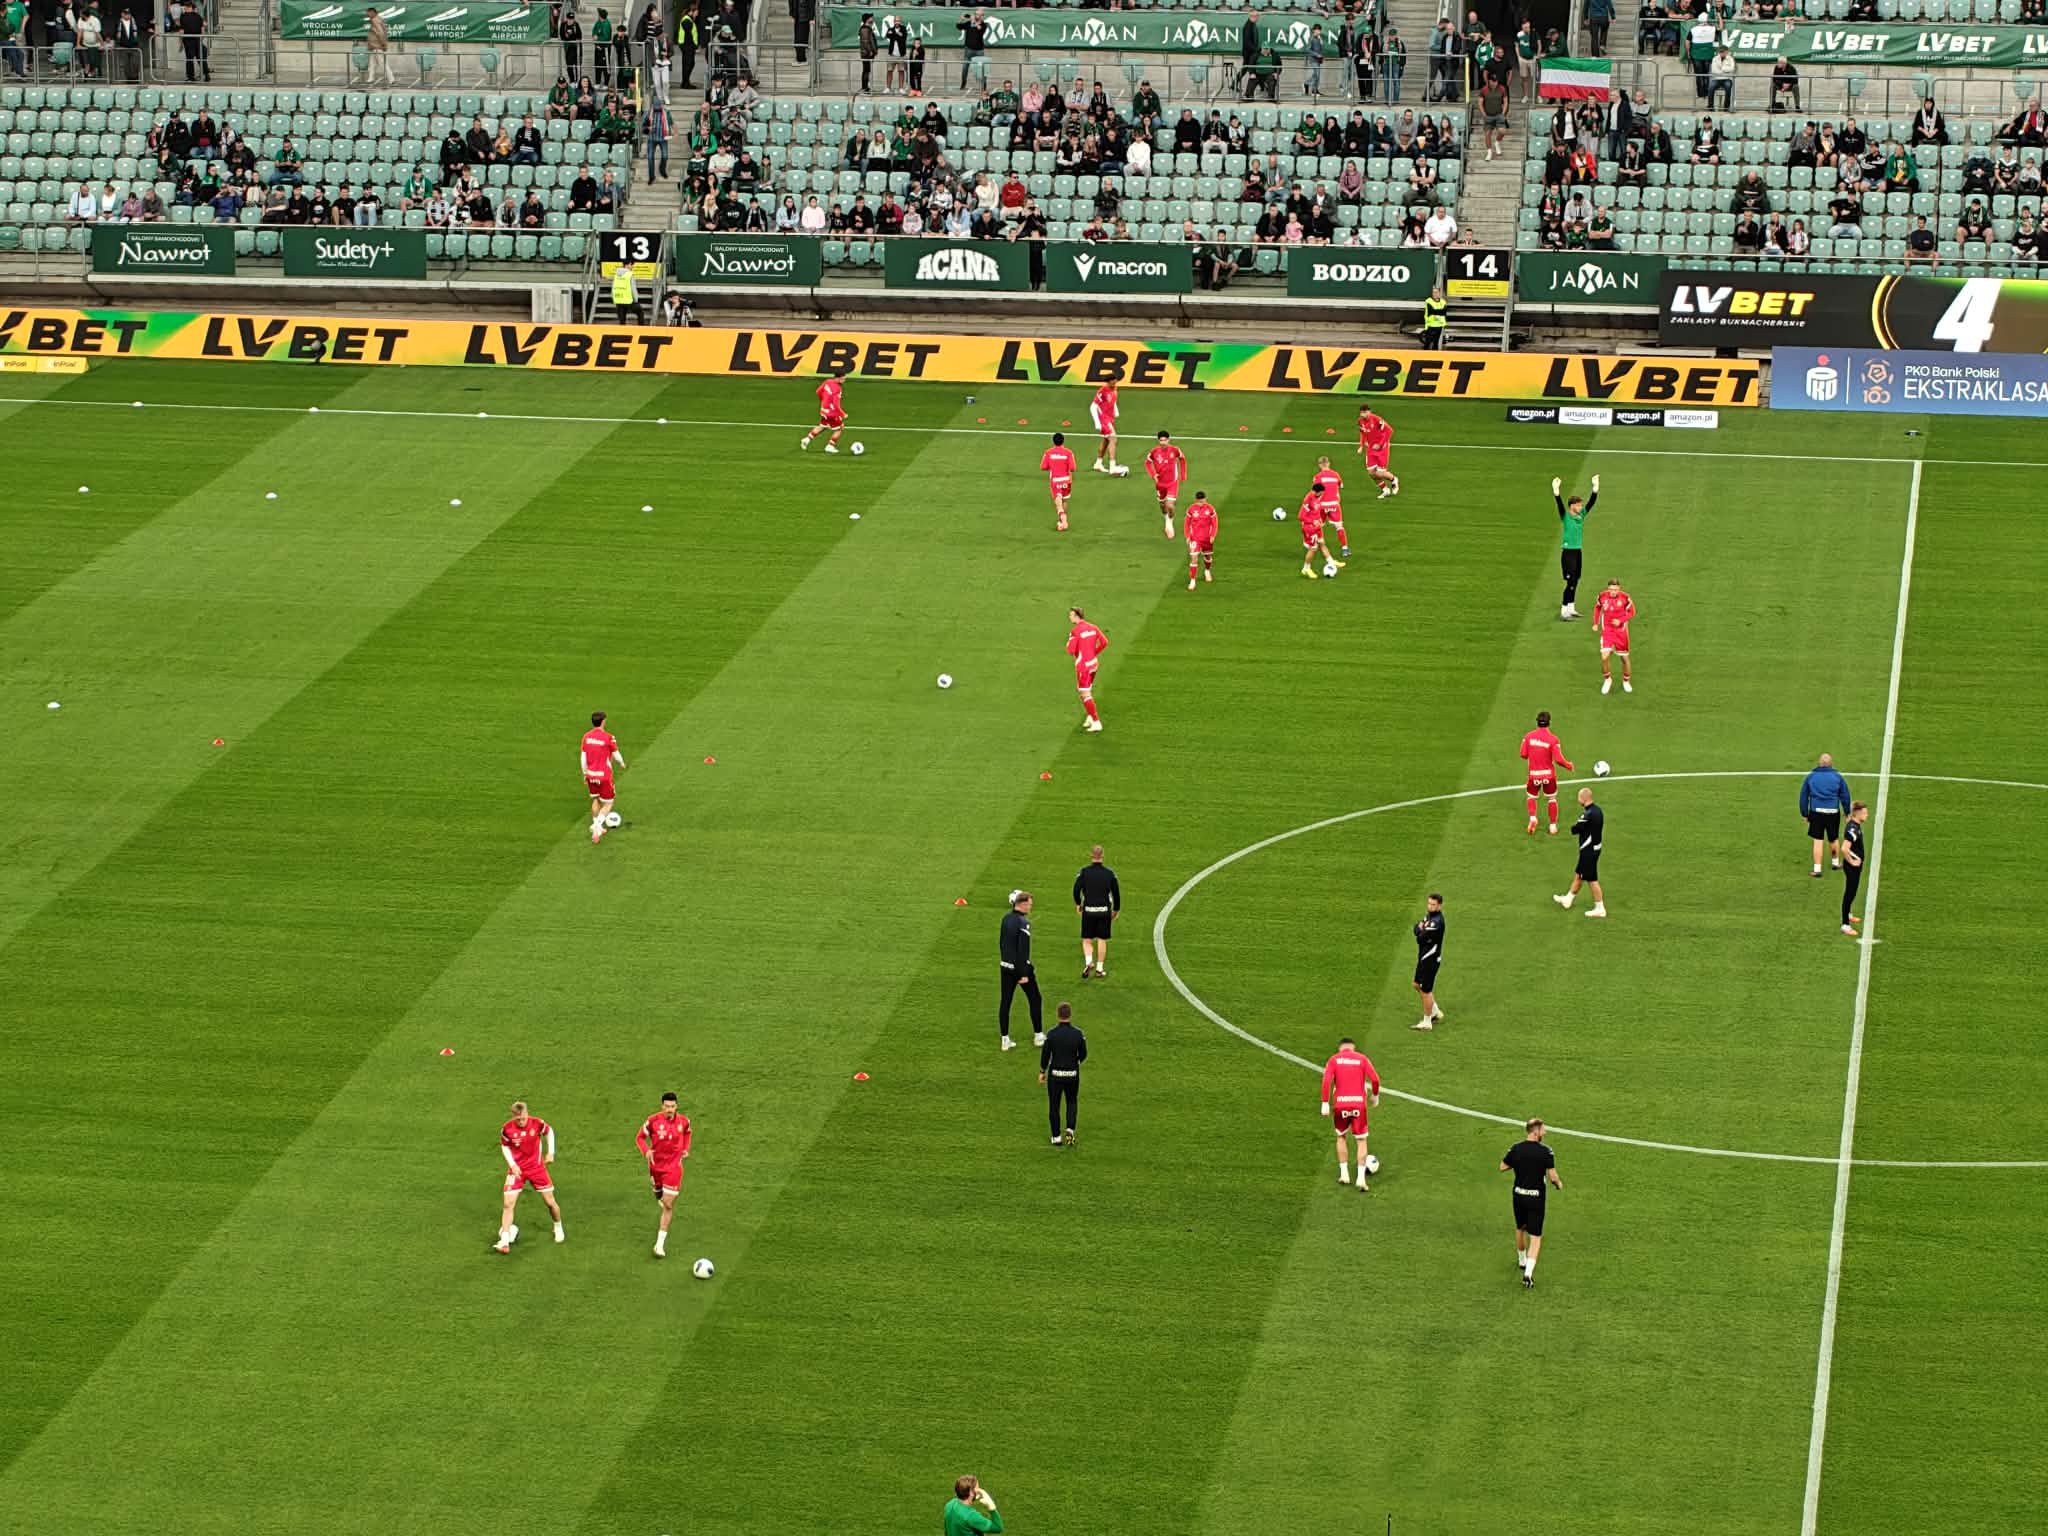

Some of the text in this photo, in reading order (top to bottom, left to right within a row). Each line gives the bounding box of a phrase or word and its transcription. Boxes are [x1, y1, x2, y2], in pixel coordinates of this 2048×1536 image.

[1060, 18, 1137, 46] JAXAN
[1162, 19, 1239, 48] JAXAN
[1811, 31, 1890, 51] LVBET
[1917, 33, 1996, 53] LVBET
[117, 241, 212, 265] Nawrot
[613, 236, 650, 260] 13
[700, 252, 797, 276] Nawrot
[915, 248, 1001, 281] ACANA
[1098, 261, 1167, 276] macron
[1312, 263, 1410, 283] BODZIO
[1460, 254, 1498, 278] 14
[1549, 262, 1639, 295] JAXAN
[1670, 285, 1814, 316] LVBET
[1932, 277, 2003, 352] 4
[202, 317, 409, 361] LVBET
[464, 325, 674, 369] LVBET
[728, 332, 941, 377] LVBET
[996, 341, 1211, 385] LVBET
[1267, 349, 1486, 395] LVBET
[1542, 358, 1758, 402] LVBET
[1904, 366, 2000, 378] PKO Bank Polski
[1904, 379, 2048, 402] EKSTRAKLASA
